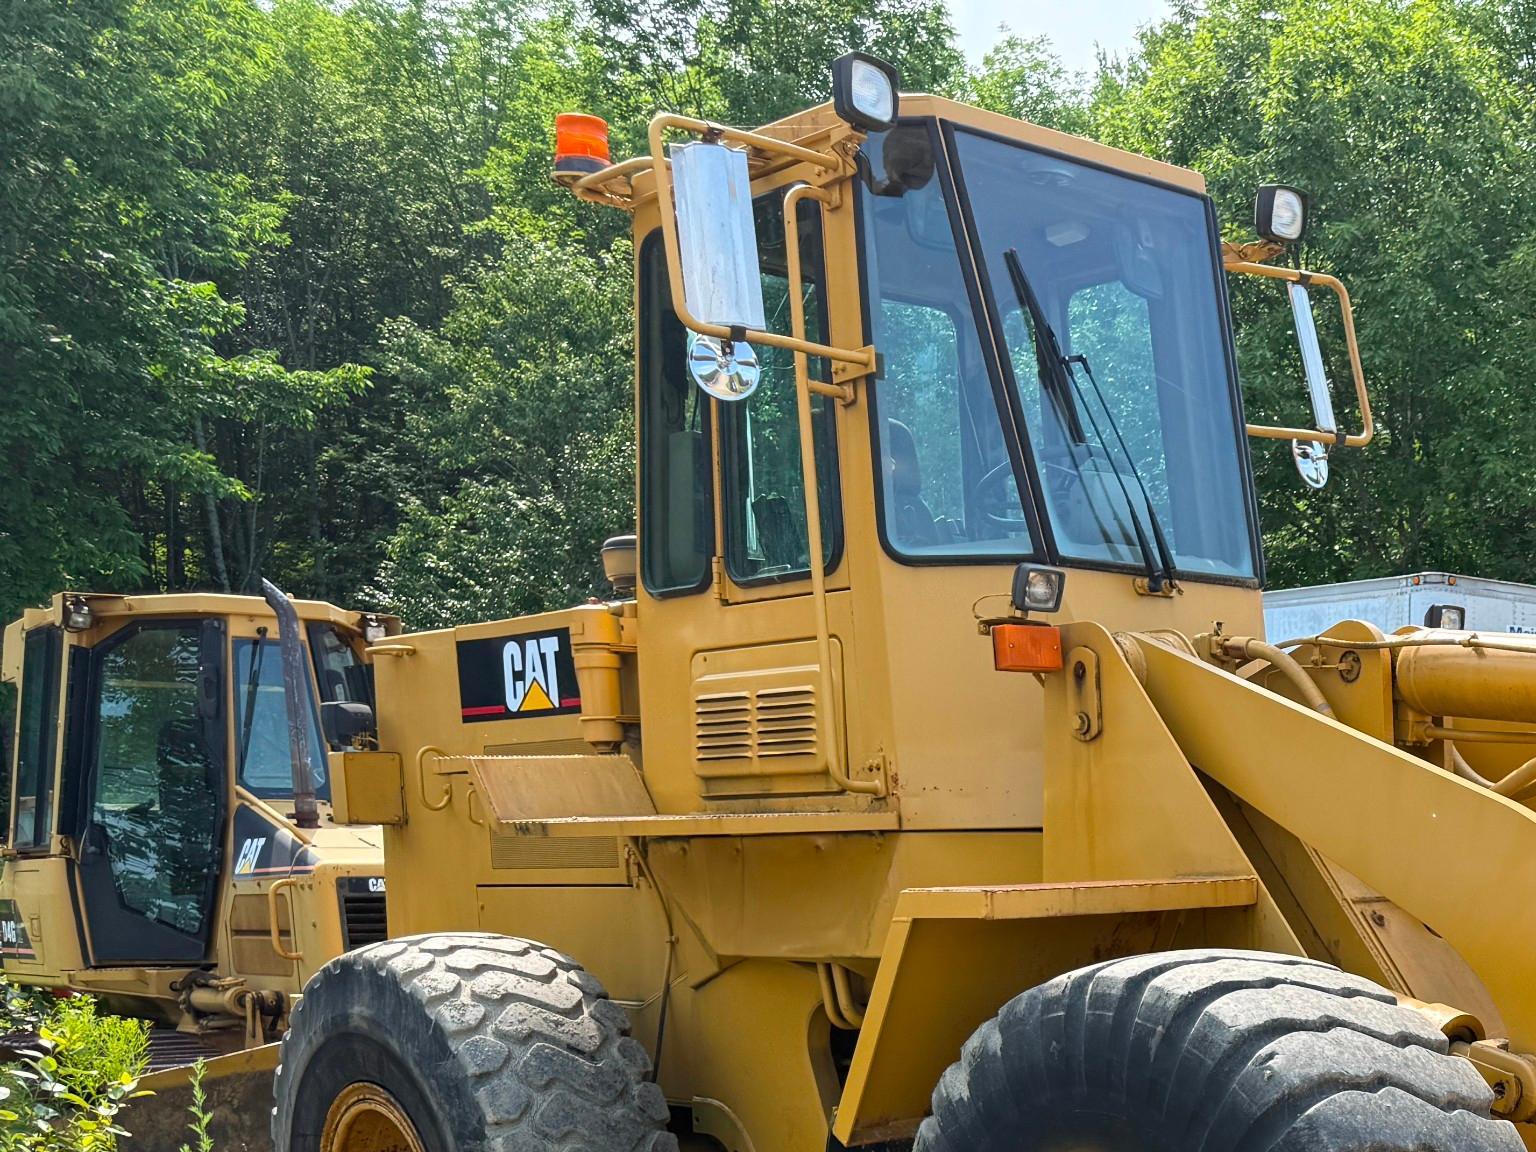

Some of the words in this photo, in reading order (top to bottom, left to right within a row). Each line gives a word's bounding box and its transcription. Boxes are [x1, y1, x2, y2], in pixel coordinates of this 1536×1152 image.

[503, 636, 560, 712] CAT
[235, 837, 266, 875] CAT
[369, 878, 386, 891] CA
